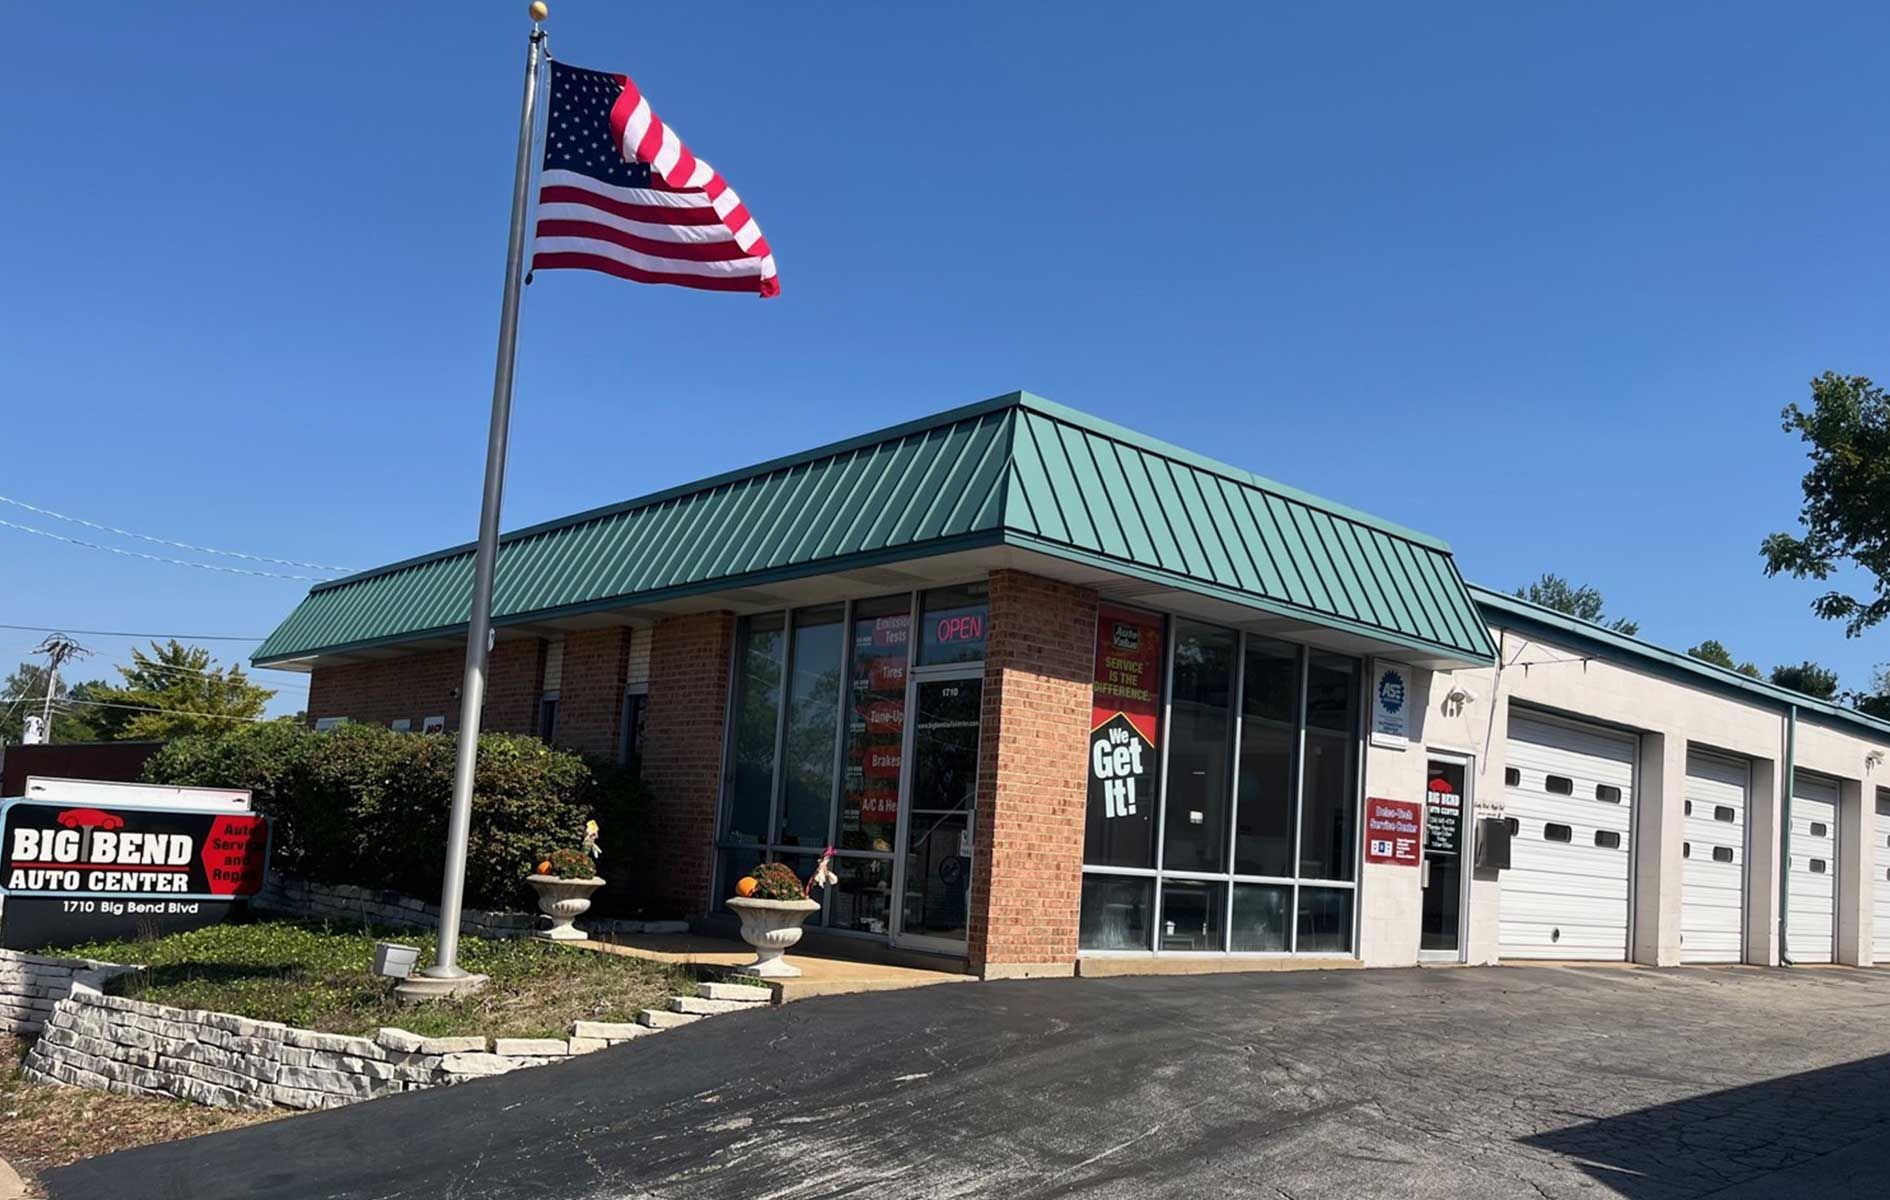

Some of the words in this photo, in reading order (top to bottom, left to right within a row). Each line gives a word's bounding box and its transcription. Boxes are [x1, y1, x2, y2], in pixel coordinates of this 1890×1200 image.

[937, 615, 982, 641] OPEN
[1115, 626, 1137, 640] Auto
[886, 631, 906, 644] Tests
[1113, 638, 1137, 650] Value
[1105, 656, 1144, 674] SERVICE
[883, 667, 903, 679] Tires
[1109, 670, 1118, 682] IS
[1121, 673, 1138, 686] THE
[942, 688, 959, 697] 1710
[1382, 682, 1402, 698] ASE
[1108, 727, 1130, 745] We
[872, 754, 902, 768] Brakes
[1093, 736, 1143, 779] Get
[1103, 777, 1136, 818] It!
[862, 799, 876, 811] A/C
[878, 800, 884, 811] &
[886, 800, 898, 811] He
[224, 823, 257, 836] Auto
[11, 828, 79, 862] BIG
[90, 832, 193, 865] BEND
[212, 838, 263, 850] Servi
[224, 855, 251, 866] and
[8, 869, 80, 890] AUTO
[88, 872, 189, 892] CENTER
[63, 900, 94, 912] 1710
[100, 901, 124, 915] Big
[127, 902, 165, 914] Bend
[167, 902, 199, 914] Blvd
